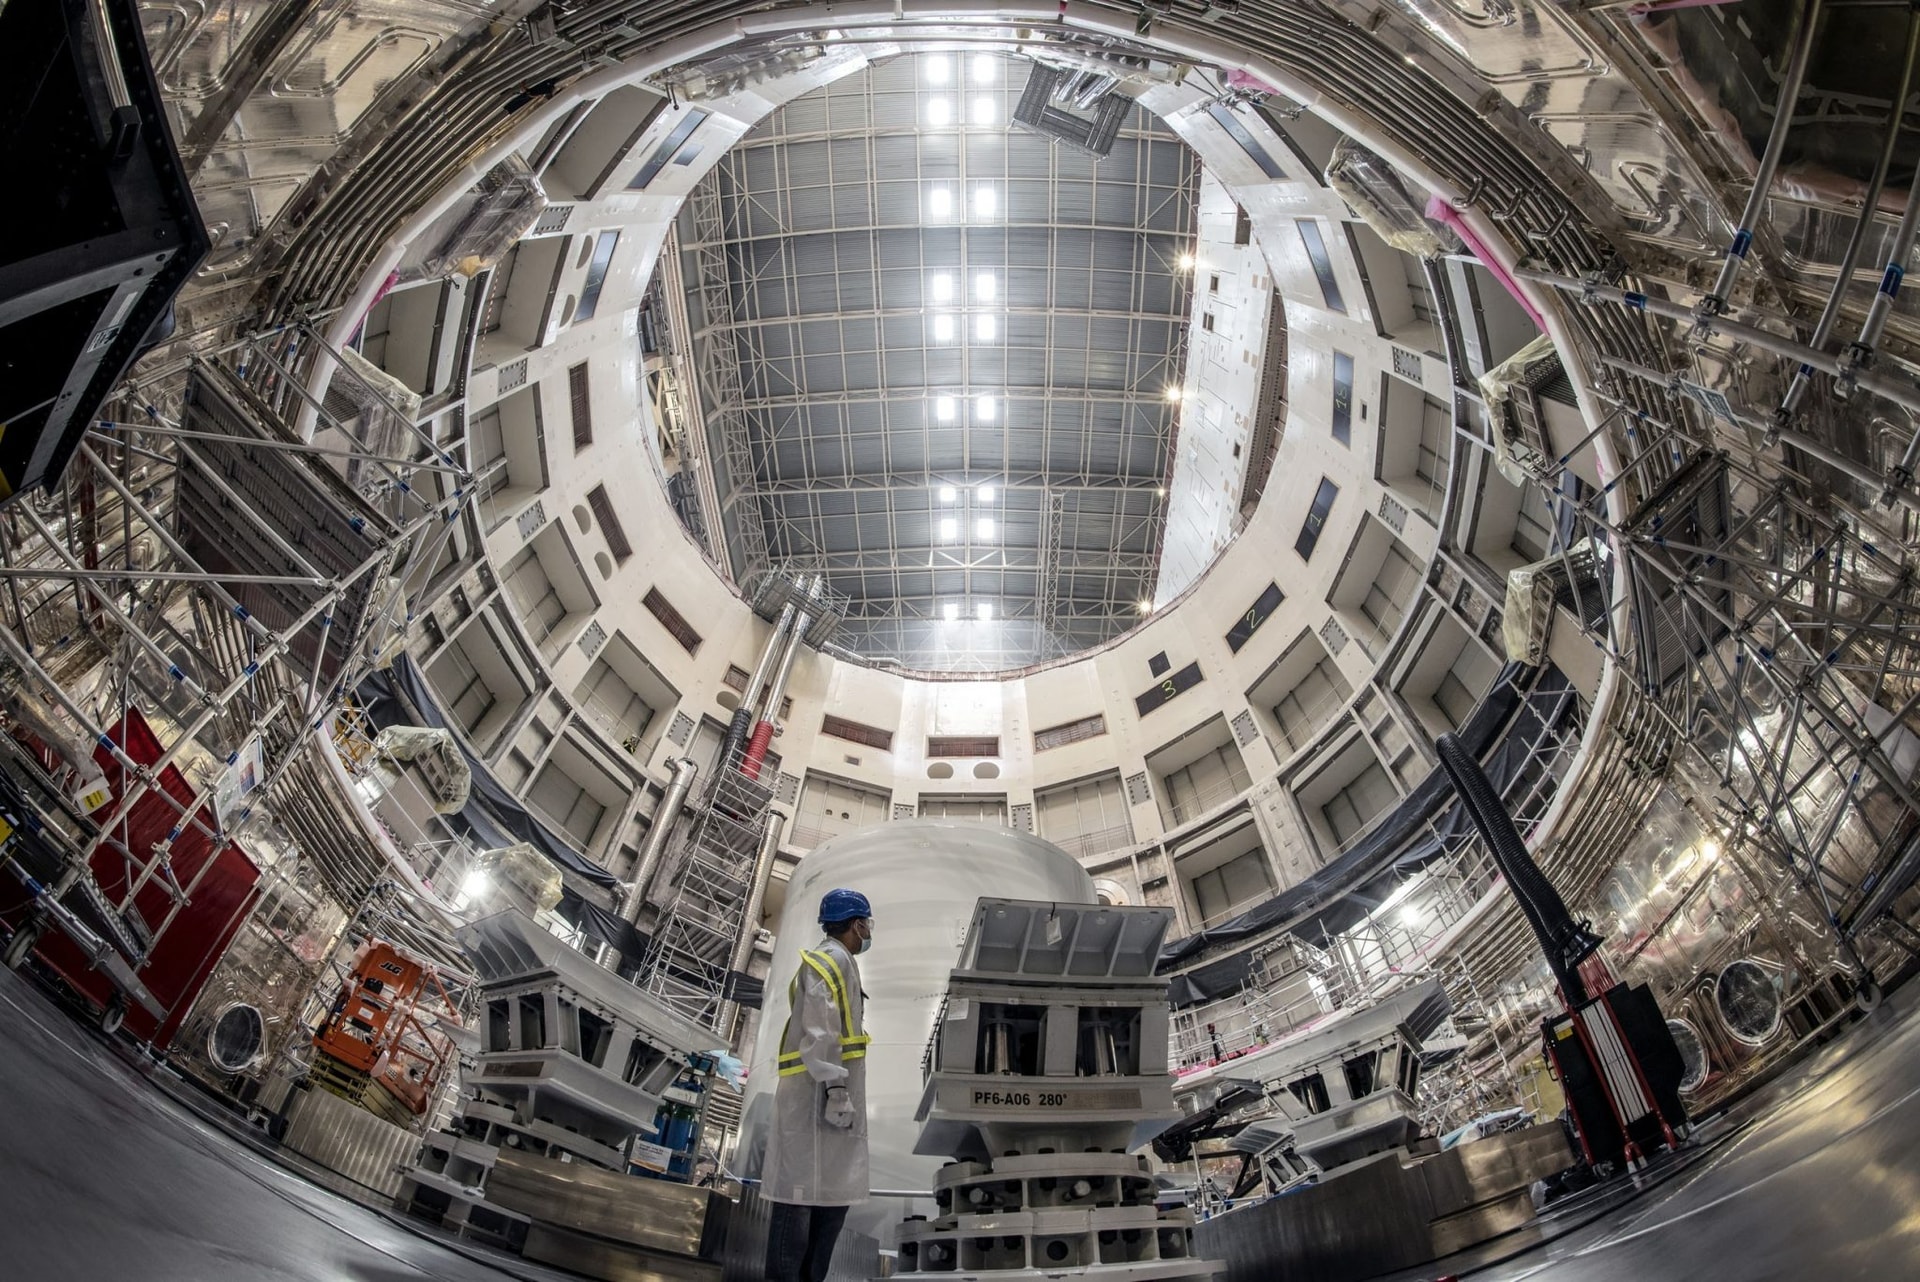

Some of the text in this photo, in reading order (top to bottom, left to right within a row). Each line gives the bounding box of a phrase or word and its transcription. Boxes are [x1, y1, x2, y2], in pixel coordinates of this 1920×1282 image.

[1246, 608, 1264, 629] 2
[1161, 679, 1177, 700] 3
[380, 962, 403, 975] JLG
[974, 1091, 1068, 1106] PF6-A06 280°
